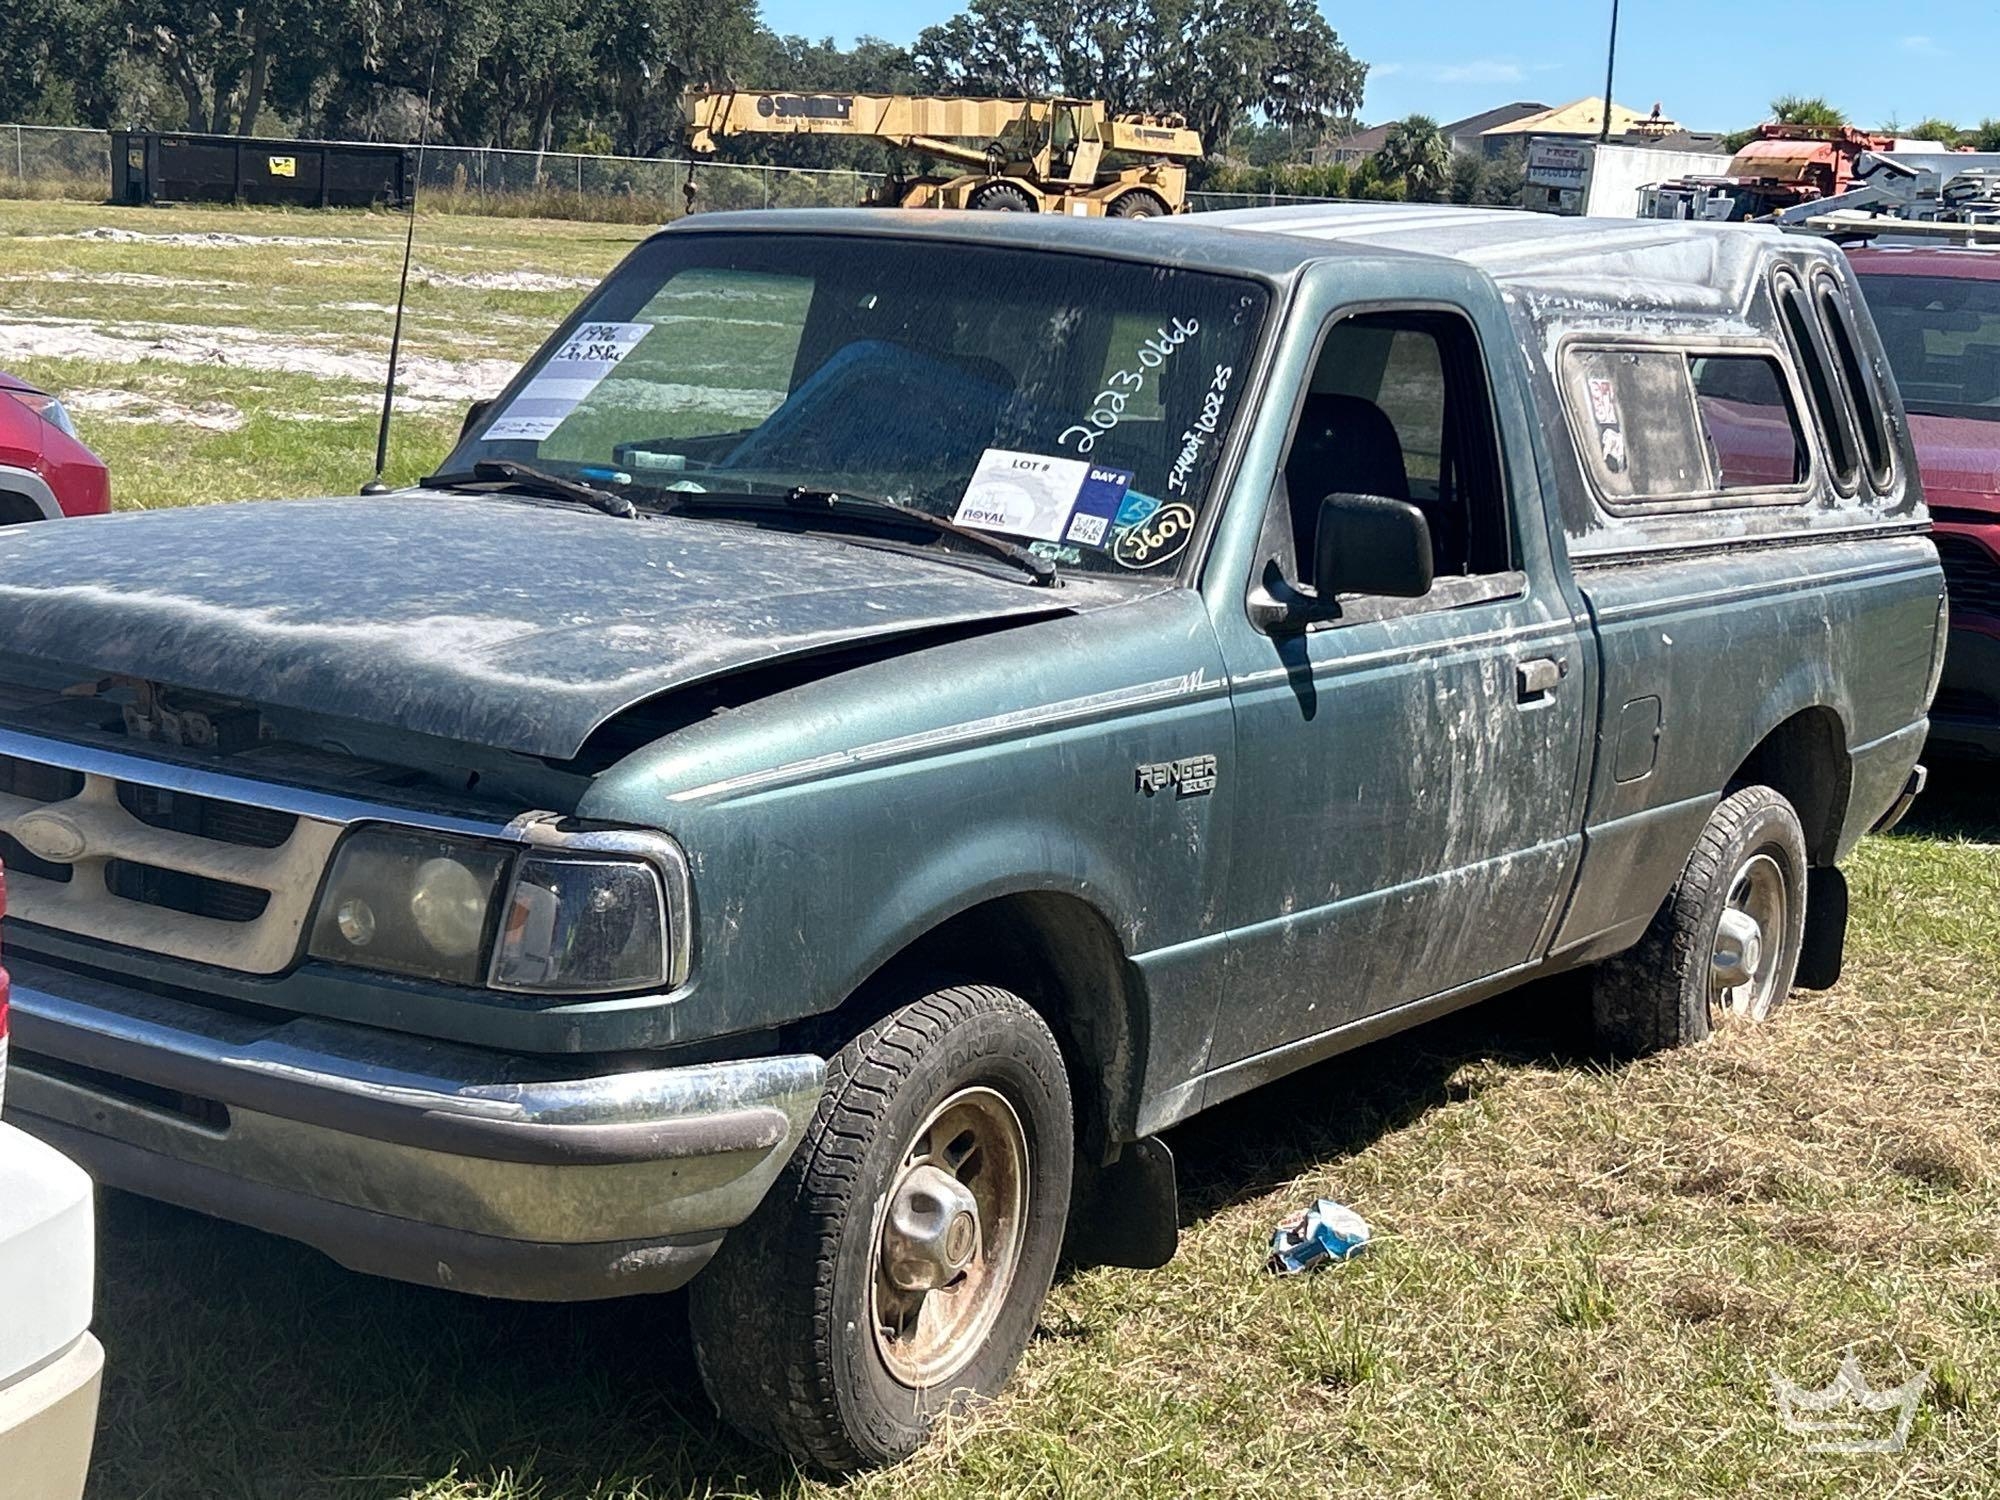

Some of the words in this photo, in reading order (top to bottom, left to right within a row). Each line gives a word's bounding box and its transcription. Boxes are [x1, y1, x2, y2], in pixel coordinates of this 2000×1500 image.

[1012, 459, 1040, 471] LOT
[1041, 463, 1051, 472] #
[1090, 470, 1117, 483] DAY
[962, 510, 1006, 523] ROYAL
[1136, 754, 1217, 792] RANGER
